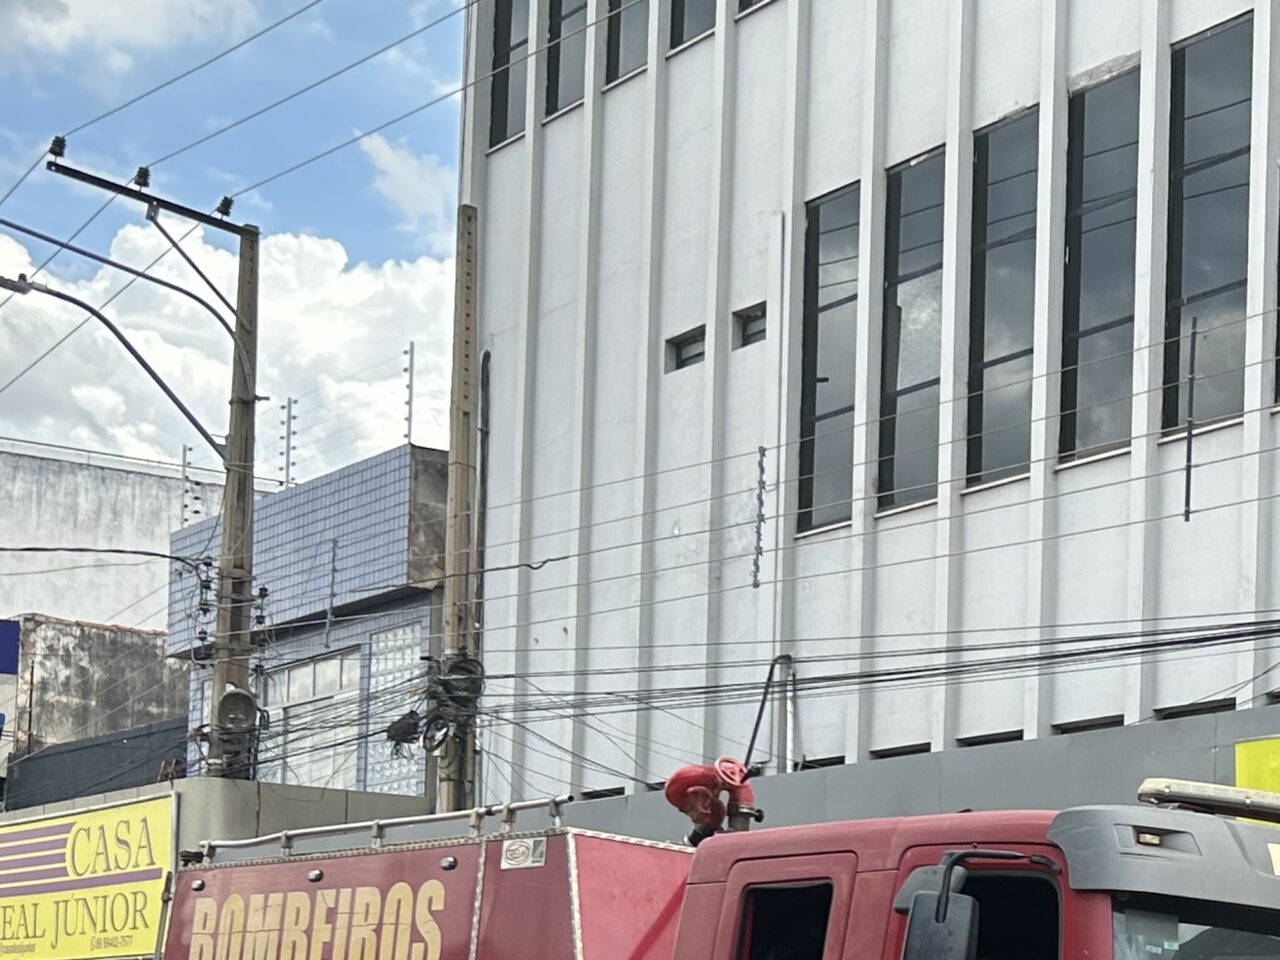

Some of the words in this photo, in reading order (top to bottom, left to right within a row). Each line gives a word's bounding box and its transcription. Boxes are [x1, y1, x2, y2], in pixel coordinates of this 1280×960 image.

[72, 816, 156, 877] CASA
[0, 903, 46, 940] EAL
[51, 891, 149, 950] JÚNIOR
